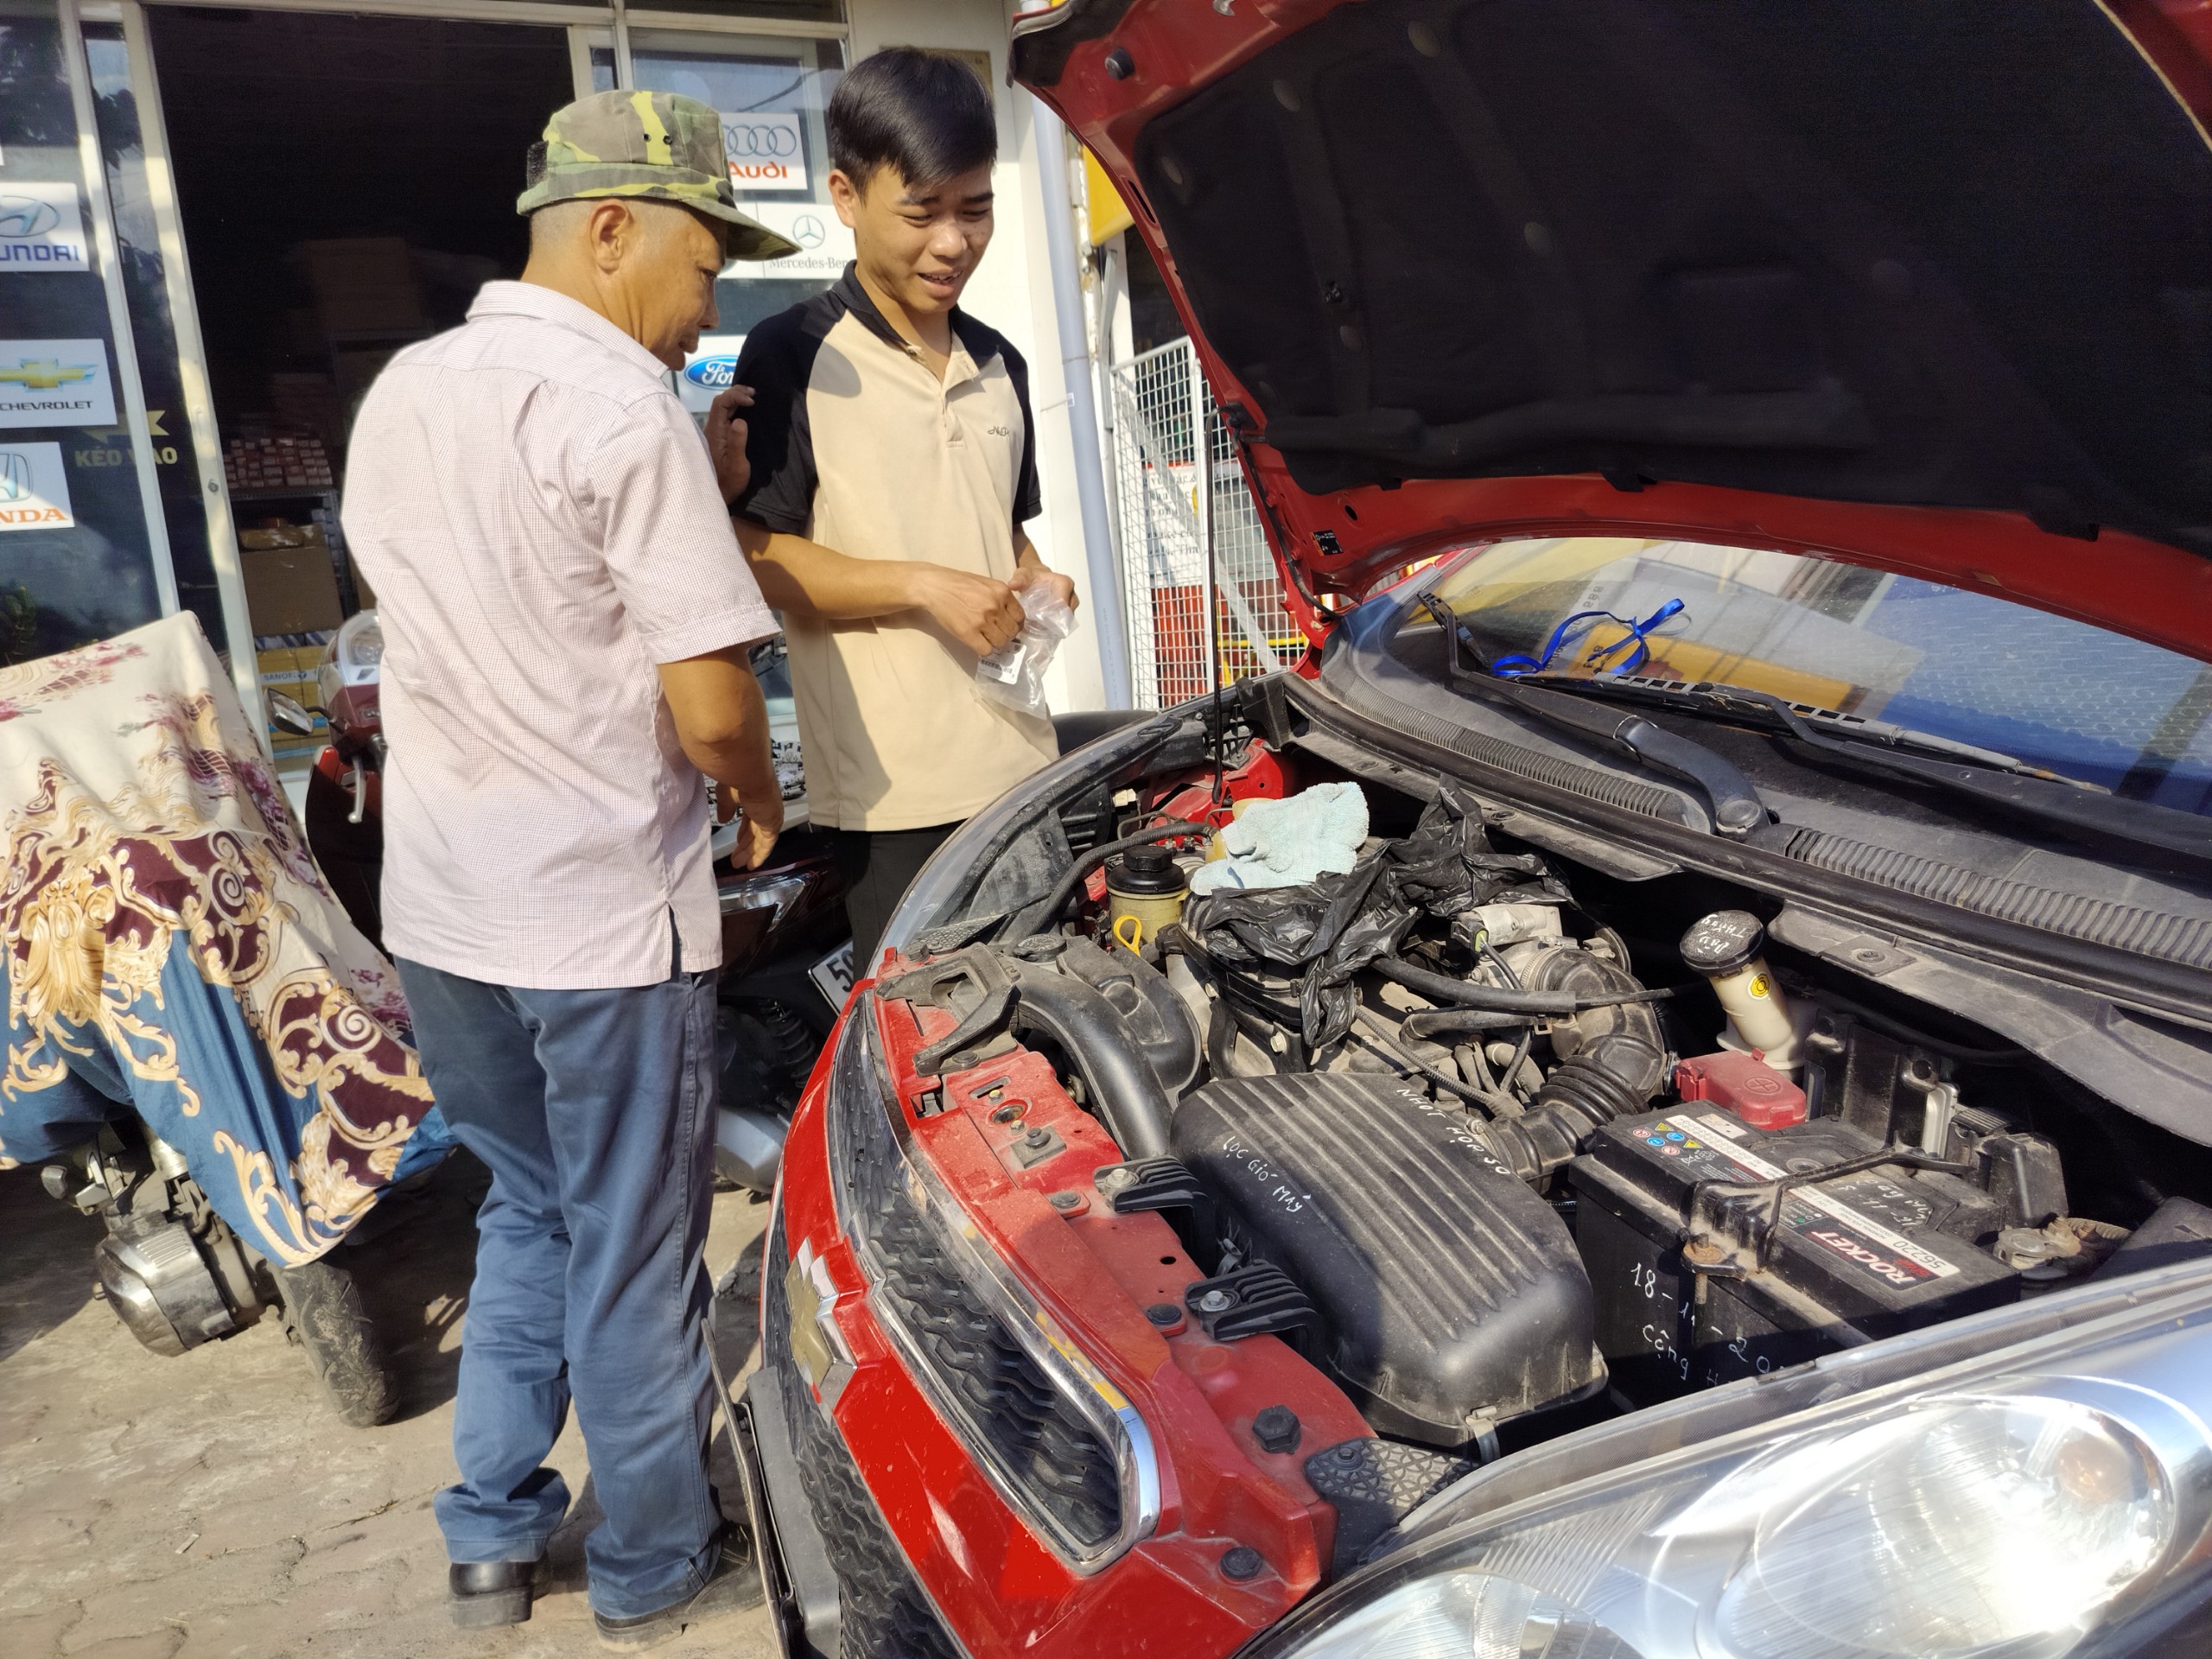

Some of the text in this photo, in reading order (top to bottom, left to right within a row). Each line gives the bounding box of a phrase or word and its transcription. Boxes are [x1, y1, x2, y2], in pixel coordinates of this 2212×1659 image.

[728, 161, 788, 179] Audi
[769, 257, 847, 270] Mercedes-Ben
[701, 360, 736, 385] For
[0, 400, 93, 410] CHEVROLET
[1811, 1230, 1916, 1285] ROCKET
[1892, 1241, 1946, 1269] 56220
